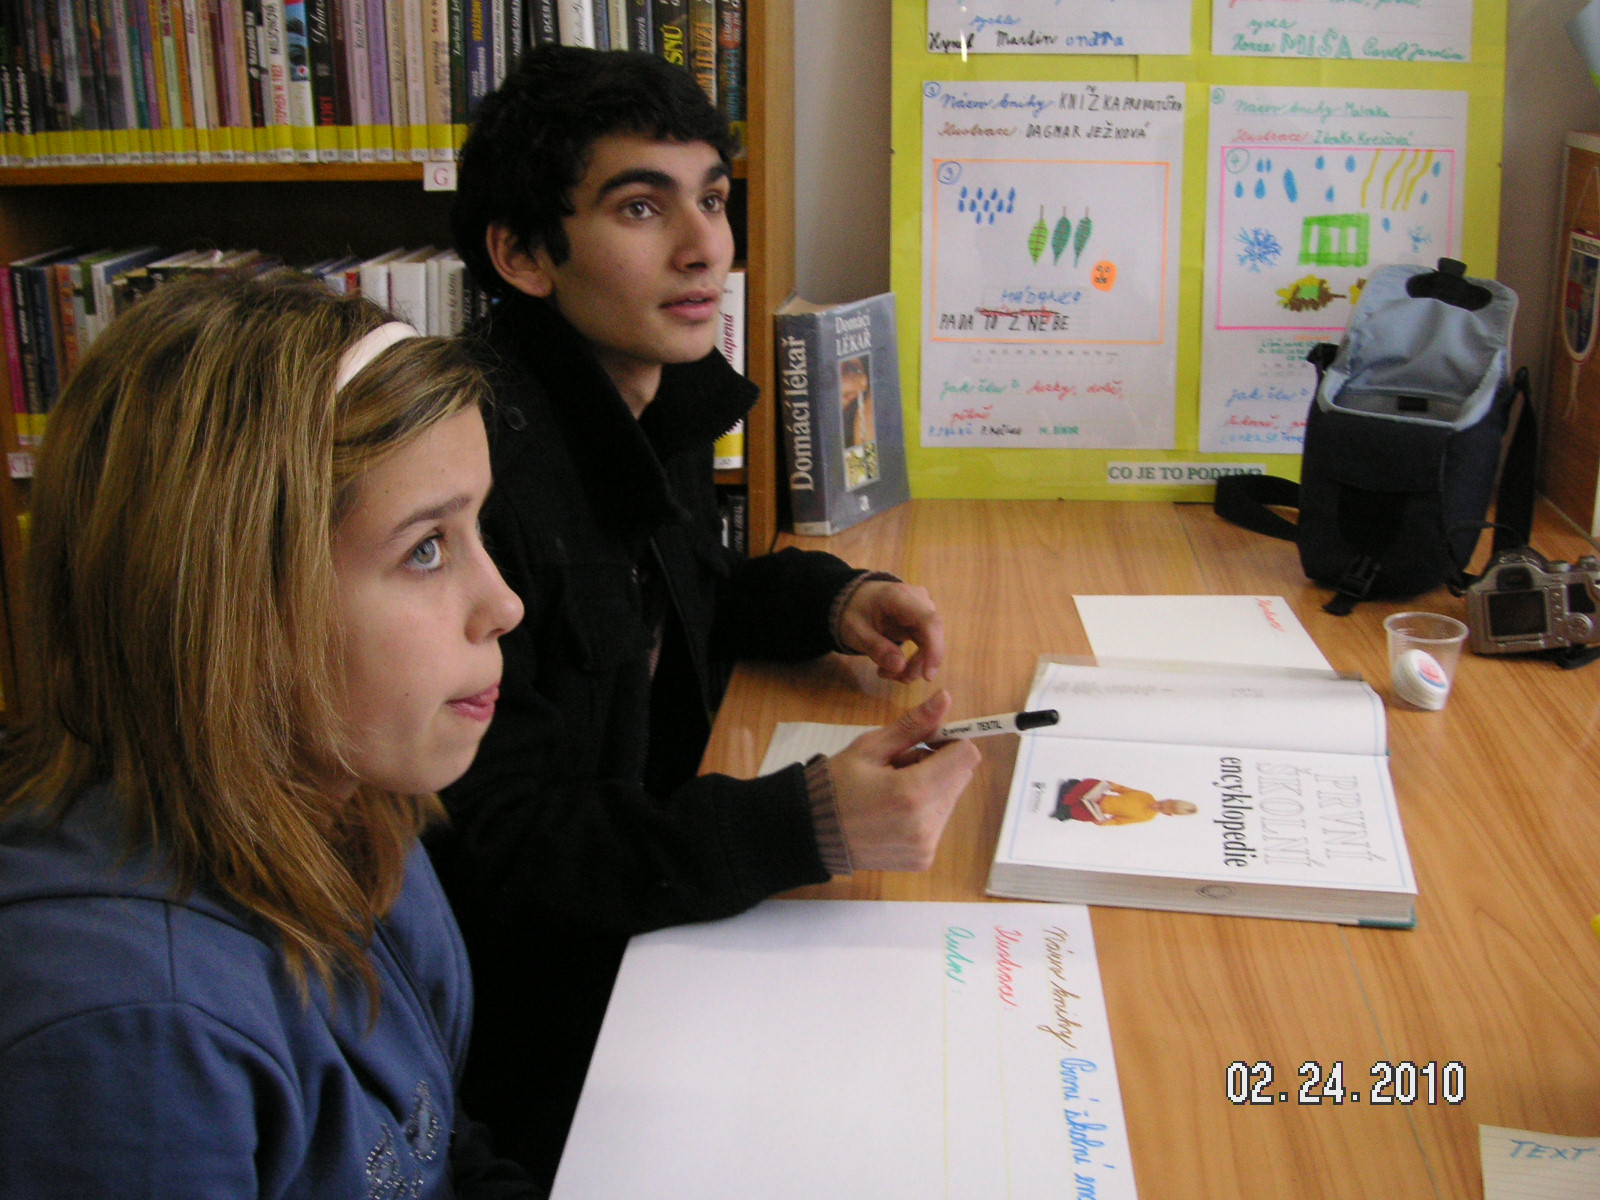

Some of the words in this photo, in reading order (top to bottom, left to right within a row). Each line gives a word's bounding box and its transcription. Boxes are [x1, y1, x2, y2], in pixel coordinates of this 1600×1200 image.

[1025, 122, 1081, 139] DAGMAR
[433, 167, 449, 188] G
[835, 308, 872, 336] Domácí
[835, 331, 872, 357] LÉKAŘ
[780, 335, 808, 396] lékař
[784, 400, 815, 491] Domácí
[1108, 466, 1132, 480] CO
[1136, 466, 1157, 480] JE
[1160, 467, 1183, 481] TO
[1211, 756, 1259, 869] encyklopedie
[1254, 762, 1324, 868] ŠKOLNÍ
[1317, 771, 1387, 863] PRVNÍ
[1510, 1138, 1597, 1161] TEXT
